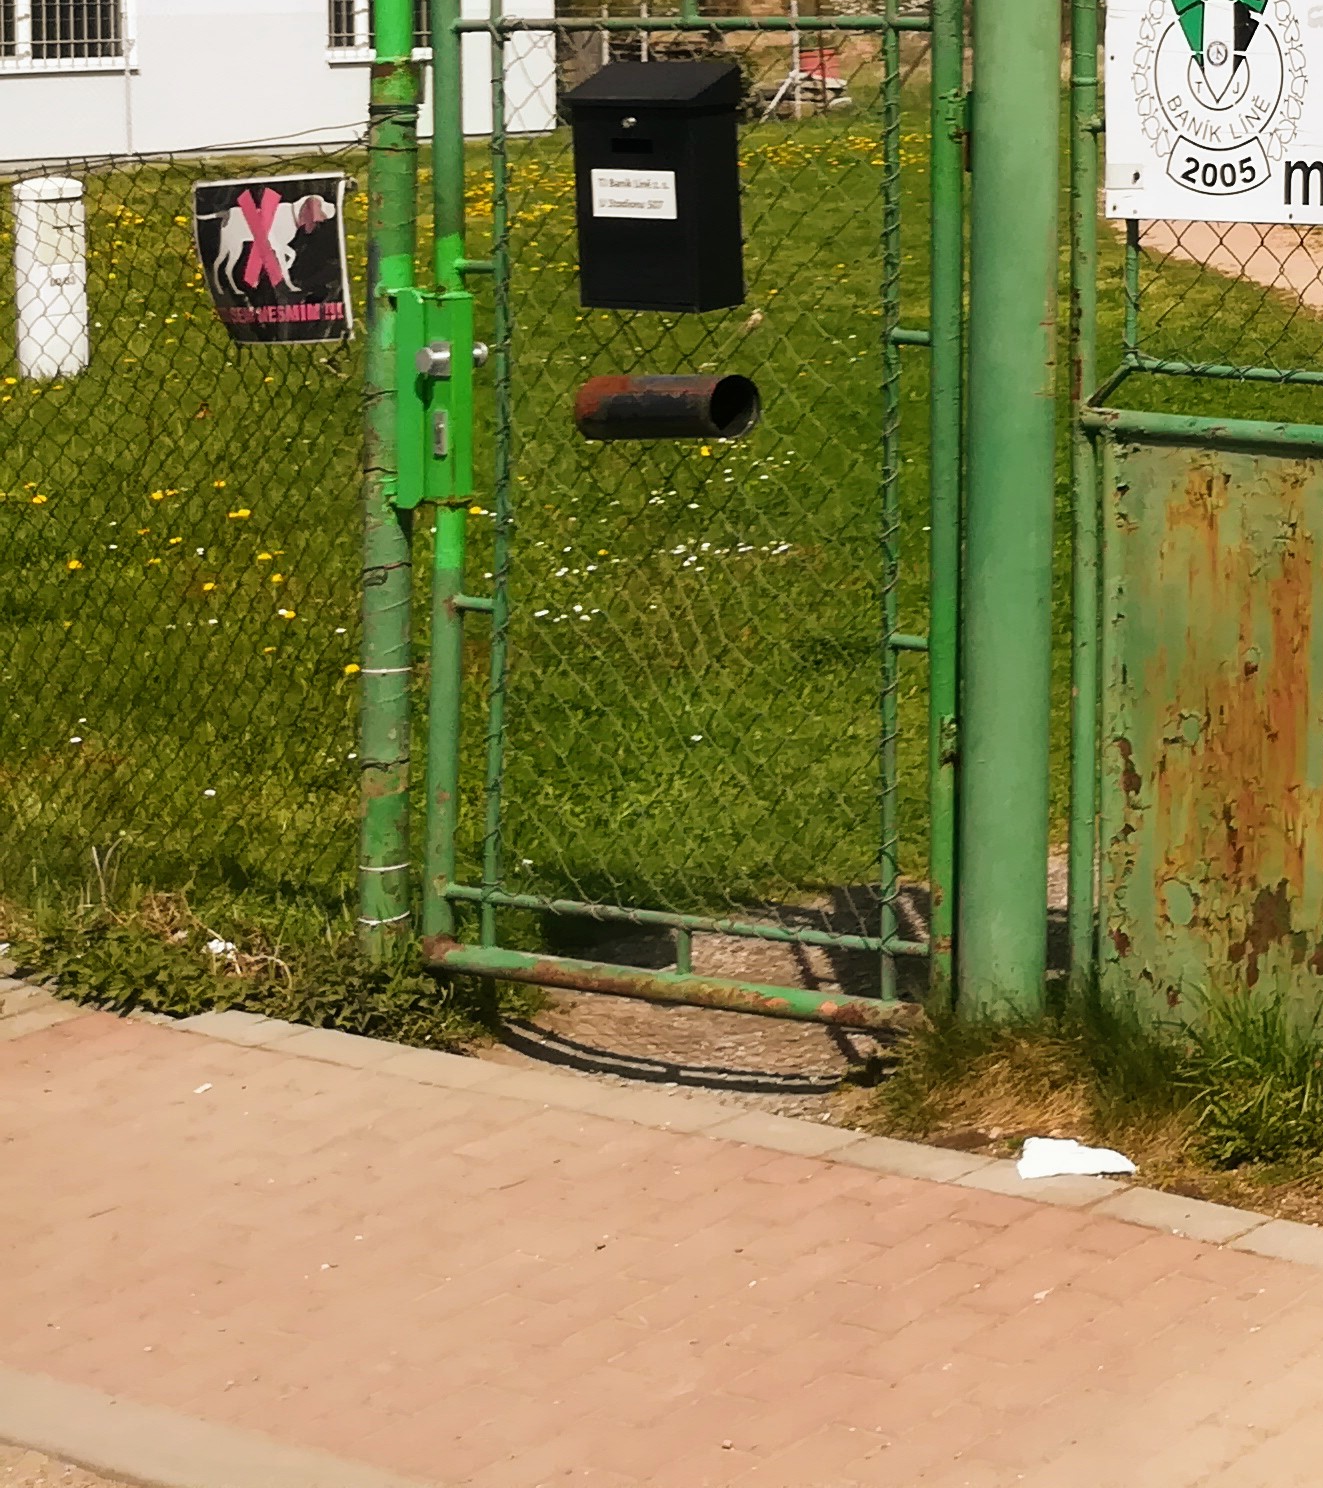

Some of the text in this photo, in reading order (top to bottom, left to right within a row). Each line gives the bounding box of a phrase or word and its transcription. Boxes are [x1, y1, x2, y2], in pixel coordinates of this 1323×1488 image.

[1166, 94, 1271, 143] BANÍK LÍNĚ
[1180, 156, 1256, 187] 2005
